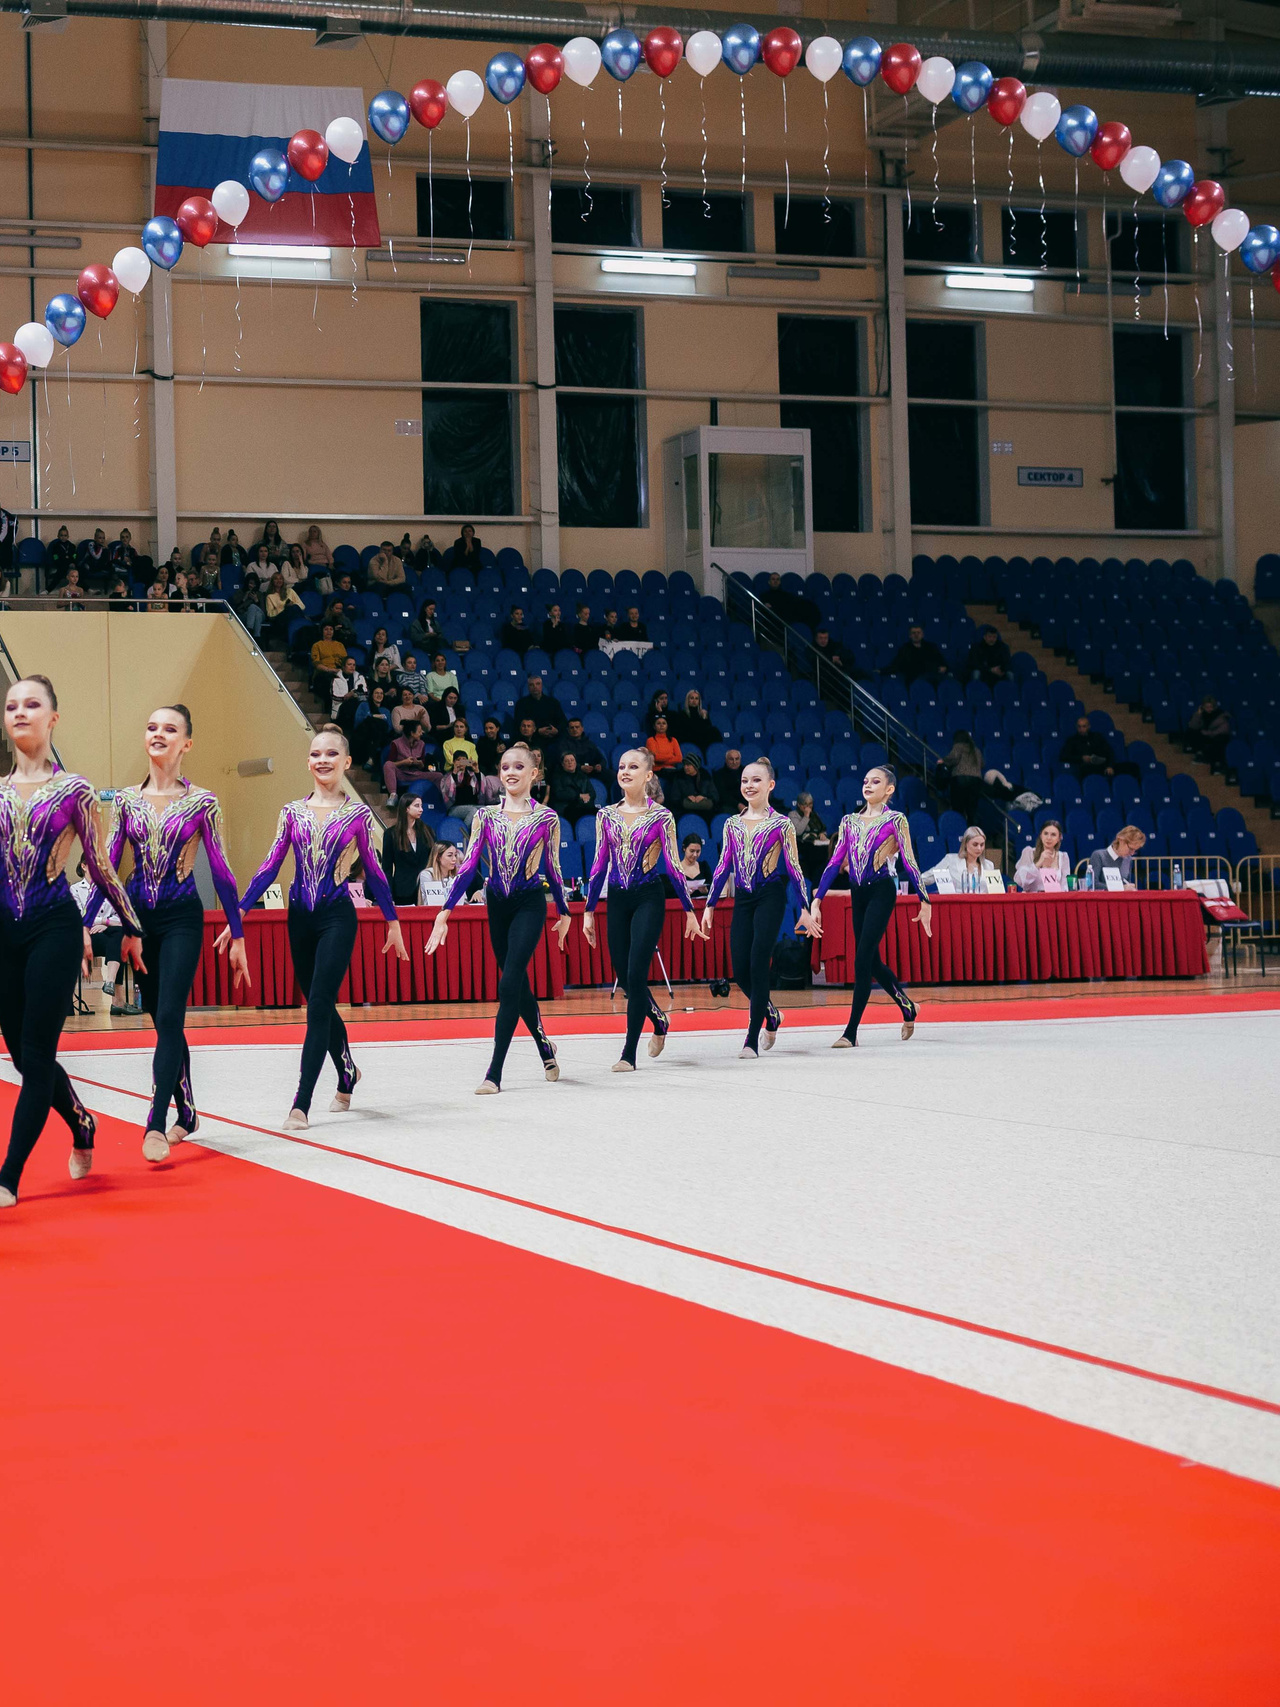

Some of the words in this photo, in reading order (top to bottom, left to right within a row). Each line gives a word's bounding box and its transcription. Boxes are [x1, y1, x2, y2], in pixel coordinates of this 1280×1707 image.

[11, 446, 19, 456] 5
[1027, 471, 1066, 482] СЕКТОР
[1067, 472, 1074, 482] 4
